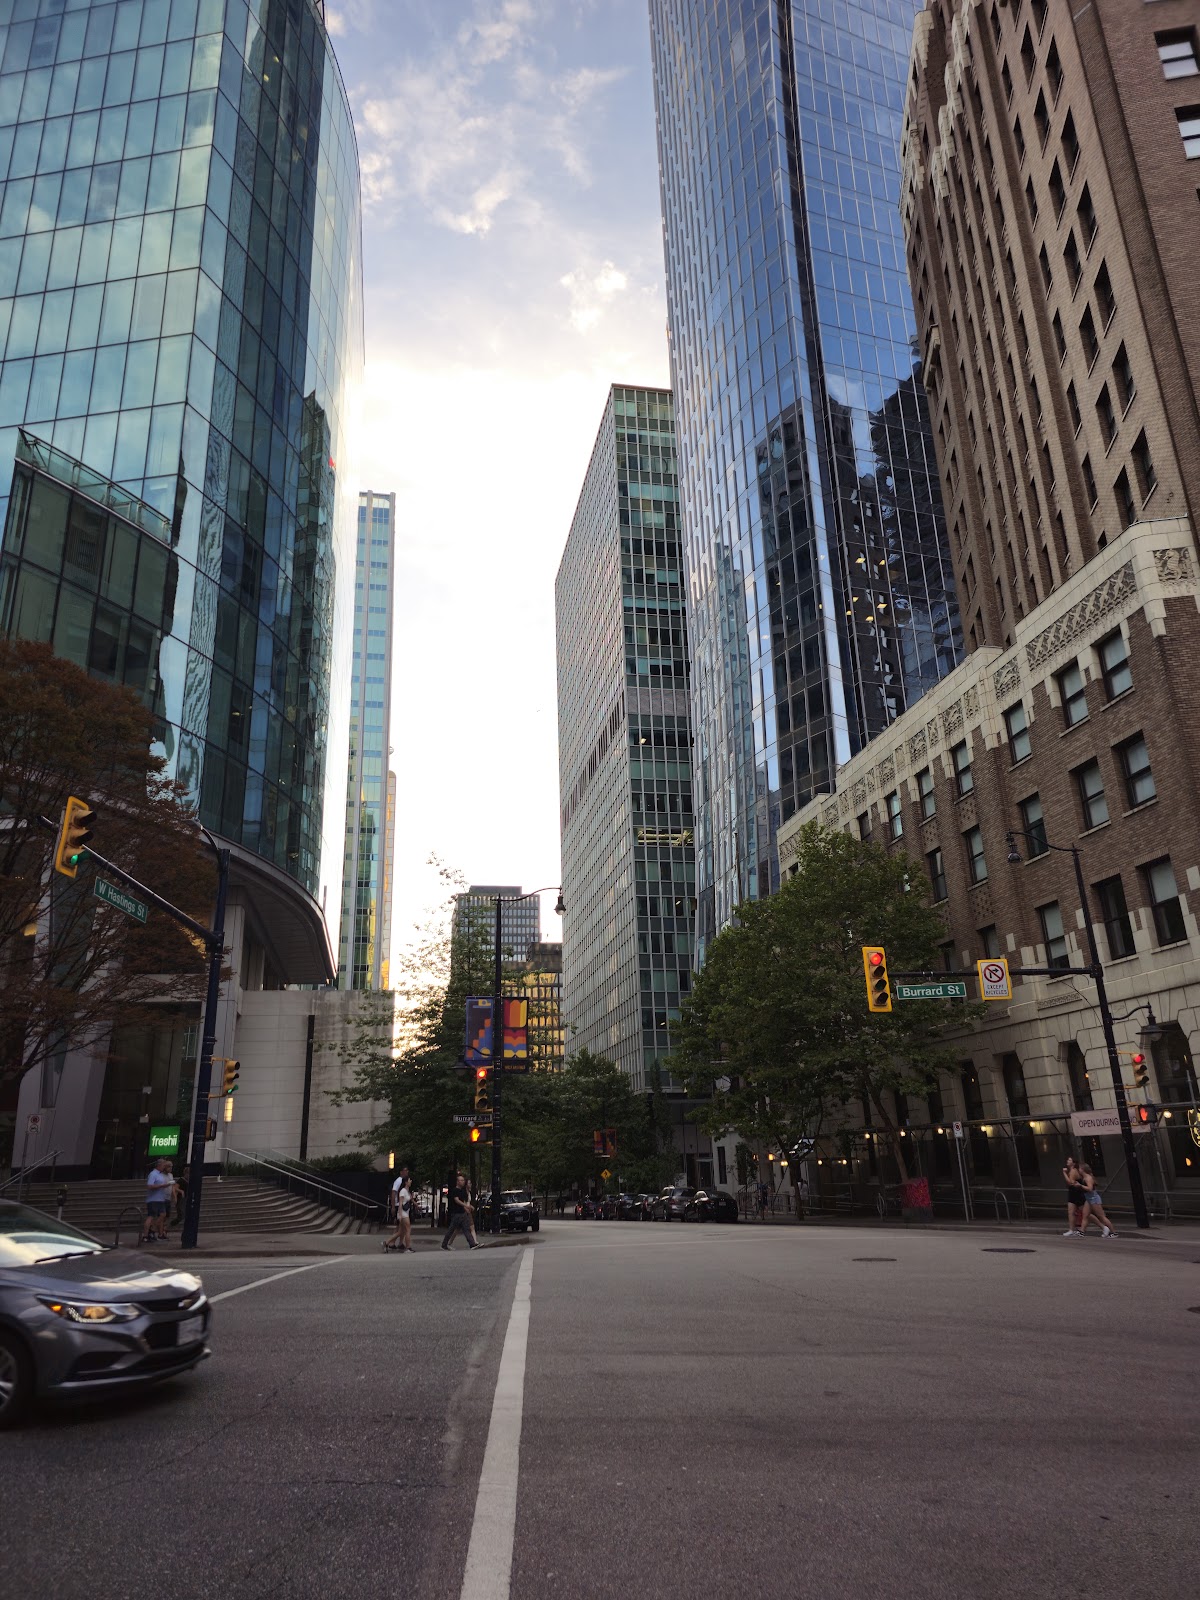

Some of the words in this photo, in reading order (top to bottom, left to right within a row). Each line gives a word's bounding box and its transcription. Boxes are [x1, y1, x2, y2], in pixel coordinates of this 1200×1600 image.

[99, 881, 106, 895] W
[107, 886, 136, 913] Hastings
[137, 904, 145, 918] St
[902, 986, 943, 997] Burrard
[947, 985, 960, 995] St
[1079, 1119, 1096, 1128] OPEN
[1096, 1117, 1120, 1127] DURING
[152, 1134, 178, 1147] freshii
